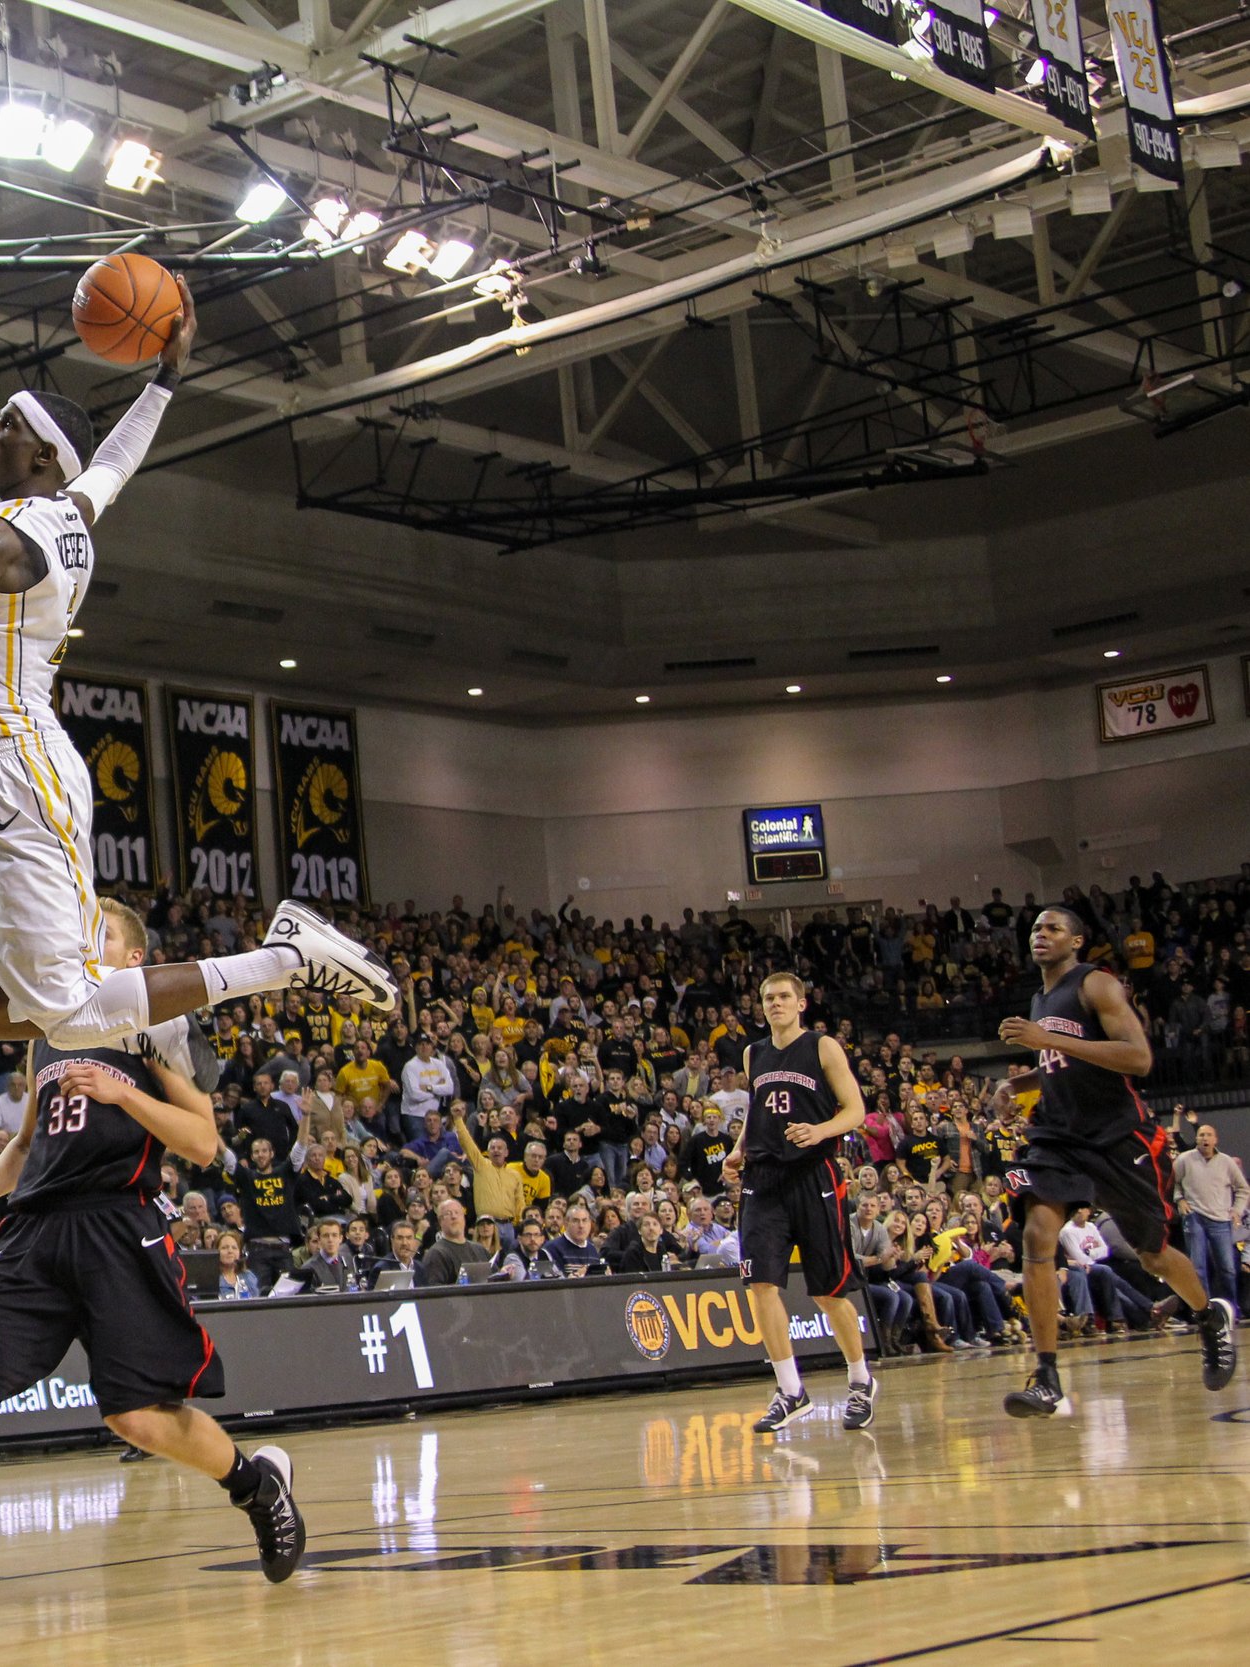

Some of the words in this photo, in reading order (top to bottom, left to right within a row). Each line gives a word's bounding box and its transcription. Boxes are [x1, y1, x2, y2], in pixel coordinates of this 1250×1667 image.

[933, 18, 986, 70] 981-1985
[62, 680, 142, 724] NCAA
[1107, 683, 1165, 707] VCU
[1172, 691, 1195, 706] NIT
[177, 699, 249, 739] NCAA
[280, 713, 350, 751] NCAA
[751, 817, 798, 832] Colonial
[752, 831, 799, 845] Scientific
[90, 833, 148, 884] 011
[189, 847, 255, 898] 2012
[291, 853, 358, 901] 2013
[1038, 1048, 1069, 1073] 44
[47, 1094, 88, 1137] 33
[764, 1091, 791, 1114] 43
[703, 1143, 726, 1157] VCU
[254, 1177, 283, 1190] VCU
[522, 1183, 538, 1198] CU
[1005, 1168, 1033, 1190] N
[662, 1288, 762, 1351] VCU
